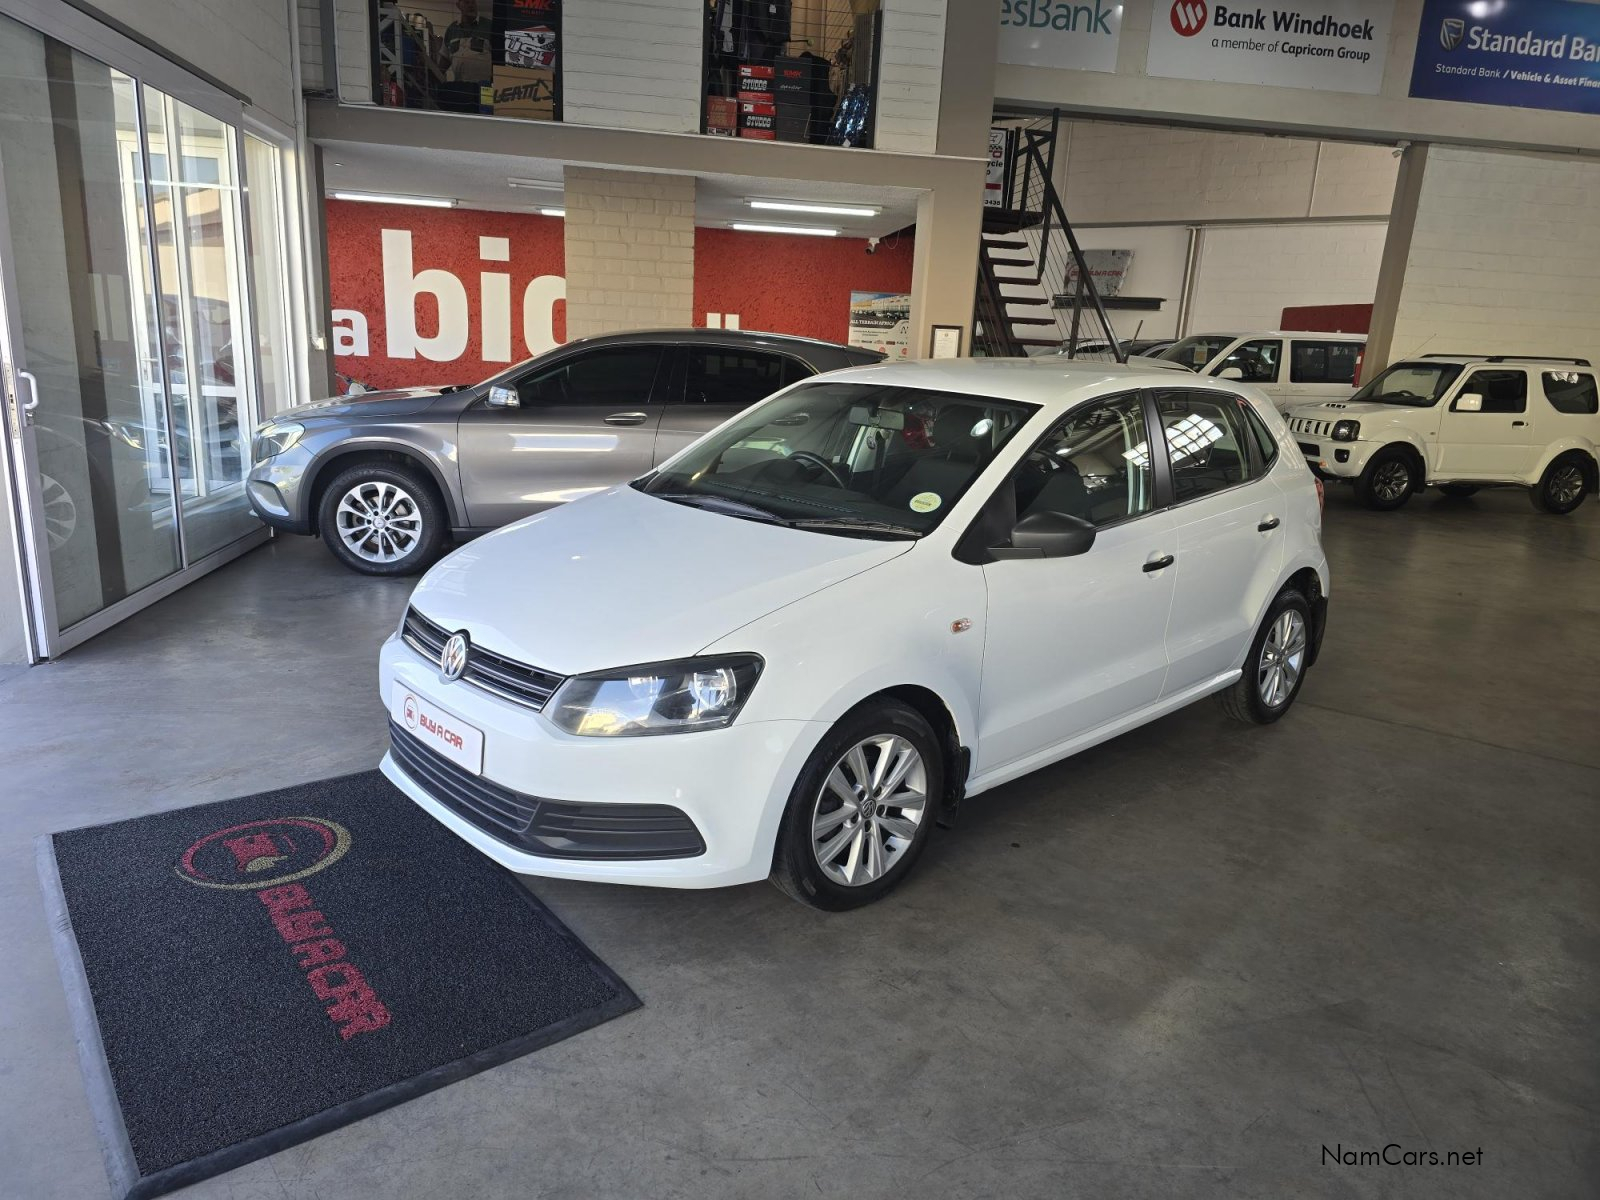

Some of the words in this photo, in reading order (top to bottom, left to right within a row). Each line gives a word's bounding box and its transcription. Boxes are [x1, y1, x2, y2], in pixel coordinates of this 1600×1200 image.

[1213, 5, 1267, 30] Bank
[1272, 10, 1374, 41] Windhoek
[1211, 38, 1219, 48] a
[1221, 38, 1265, 52] member
[1267, 41, 1280, 53] of
[1281, 42, 1334, 58] Capricorn
[1337, 46, 1370, 64] Group
[1467, 25, 1567, 59] Standard
[1435, 63, 1477, 76] Standard
[1478, 67, 1501, 79] Bank
[1543, 74, 1551, 84] &
[1552, 75, 1577, 86] Asset
[332, 308, 369, 357] a
[419, 713, 437, 735] BUY
[436, 725, 443, 739] A
[443, 728, 463, 751] CAR
[257, 883, 335, 944] BUY
[306, 962, 392, 1041] CAR
